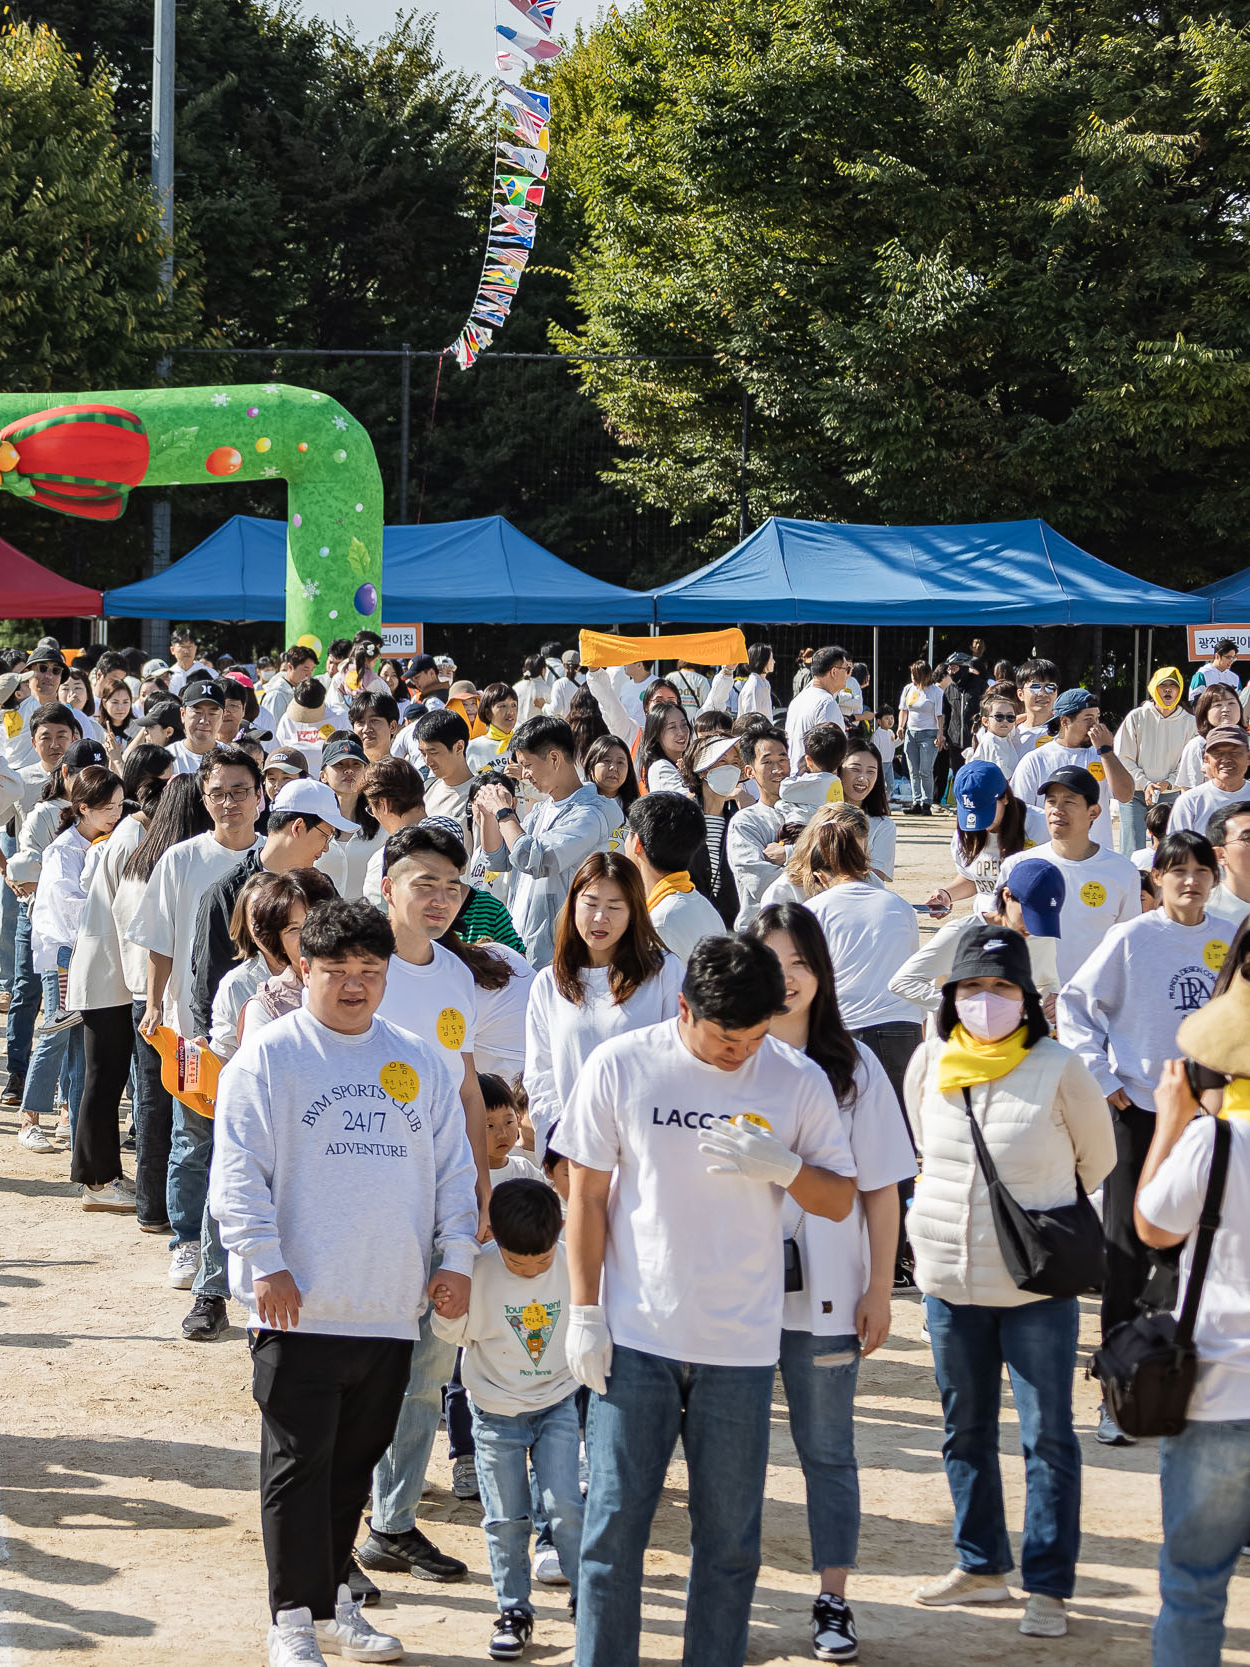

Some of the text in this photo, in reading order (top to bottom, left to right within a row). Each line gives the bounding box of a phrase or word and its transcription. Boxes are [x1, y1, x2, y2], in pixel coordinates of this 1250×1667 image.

[962, 794, 976, 809] LA
[301, 1094, 333, 1128] BVM
[331, 1083, 387, 1101] SPORTS
[342, 1110, 387, 1133] 24/7
[325, 1142, 408, 1158] ADVENTURE
